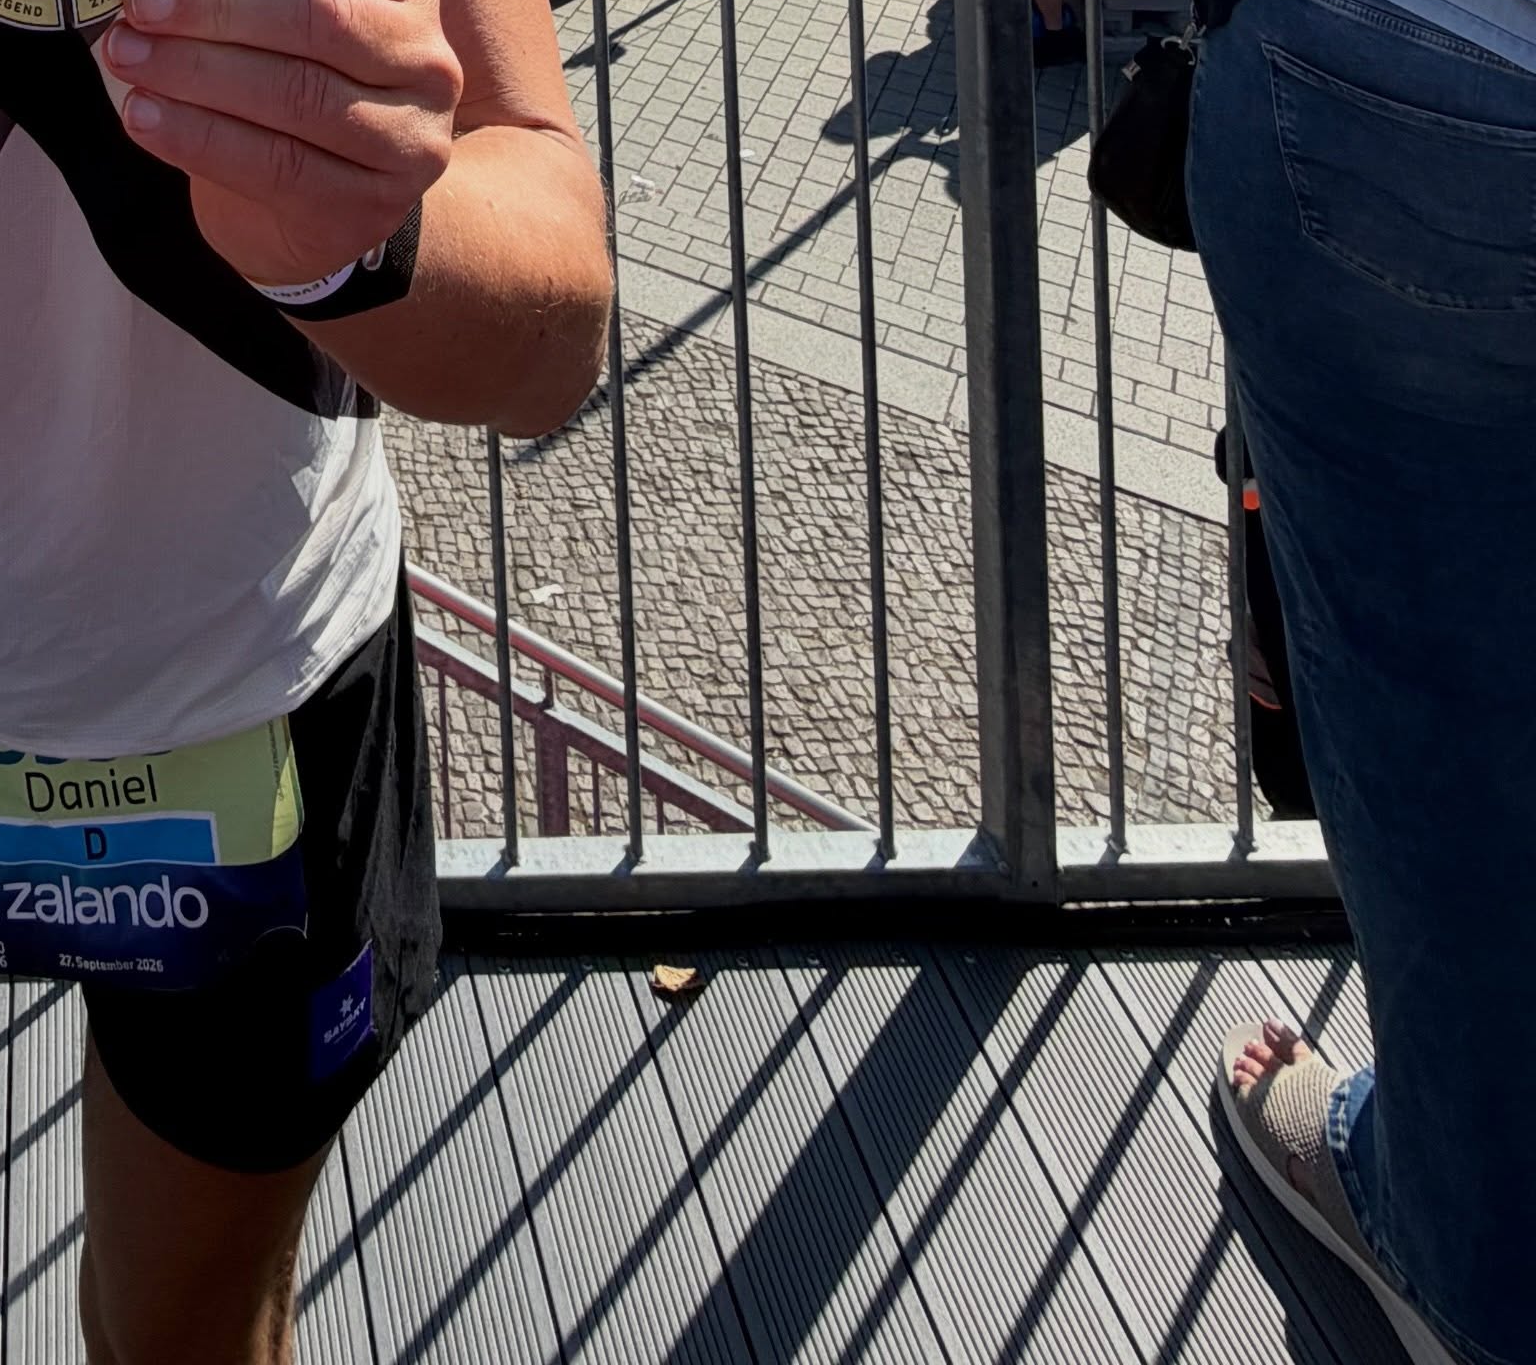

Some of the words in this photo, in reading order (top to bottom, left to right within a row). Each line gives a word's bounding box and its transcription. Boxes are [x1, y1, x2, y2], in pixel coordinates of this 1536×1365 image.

[25, 764, 158, 813] Daniel
[84, 827, 108, 860] D
[3, 875, 209, 929] zalando
[59, 953, 75, 967] 27.
[75, 956, 134, 972] September
[136, 958, 164, 973] 2026
